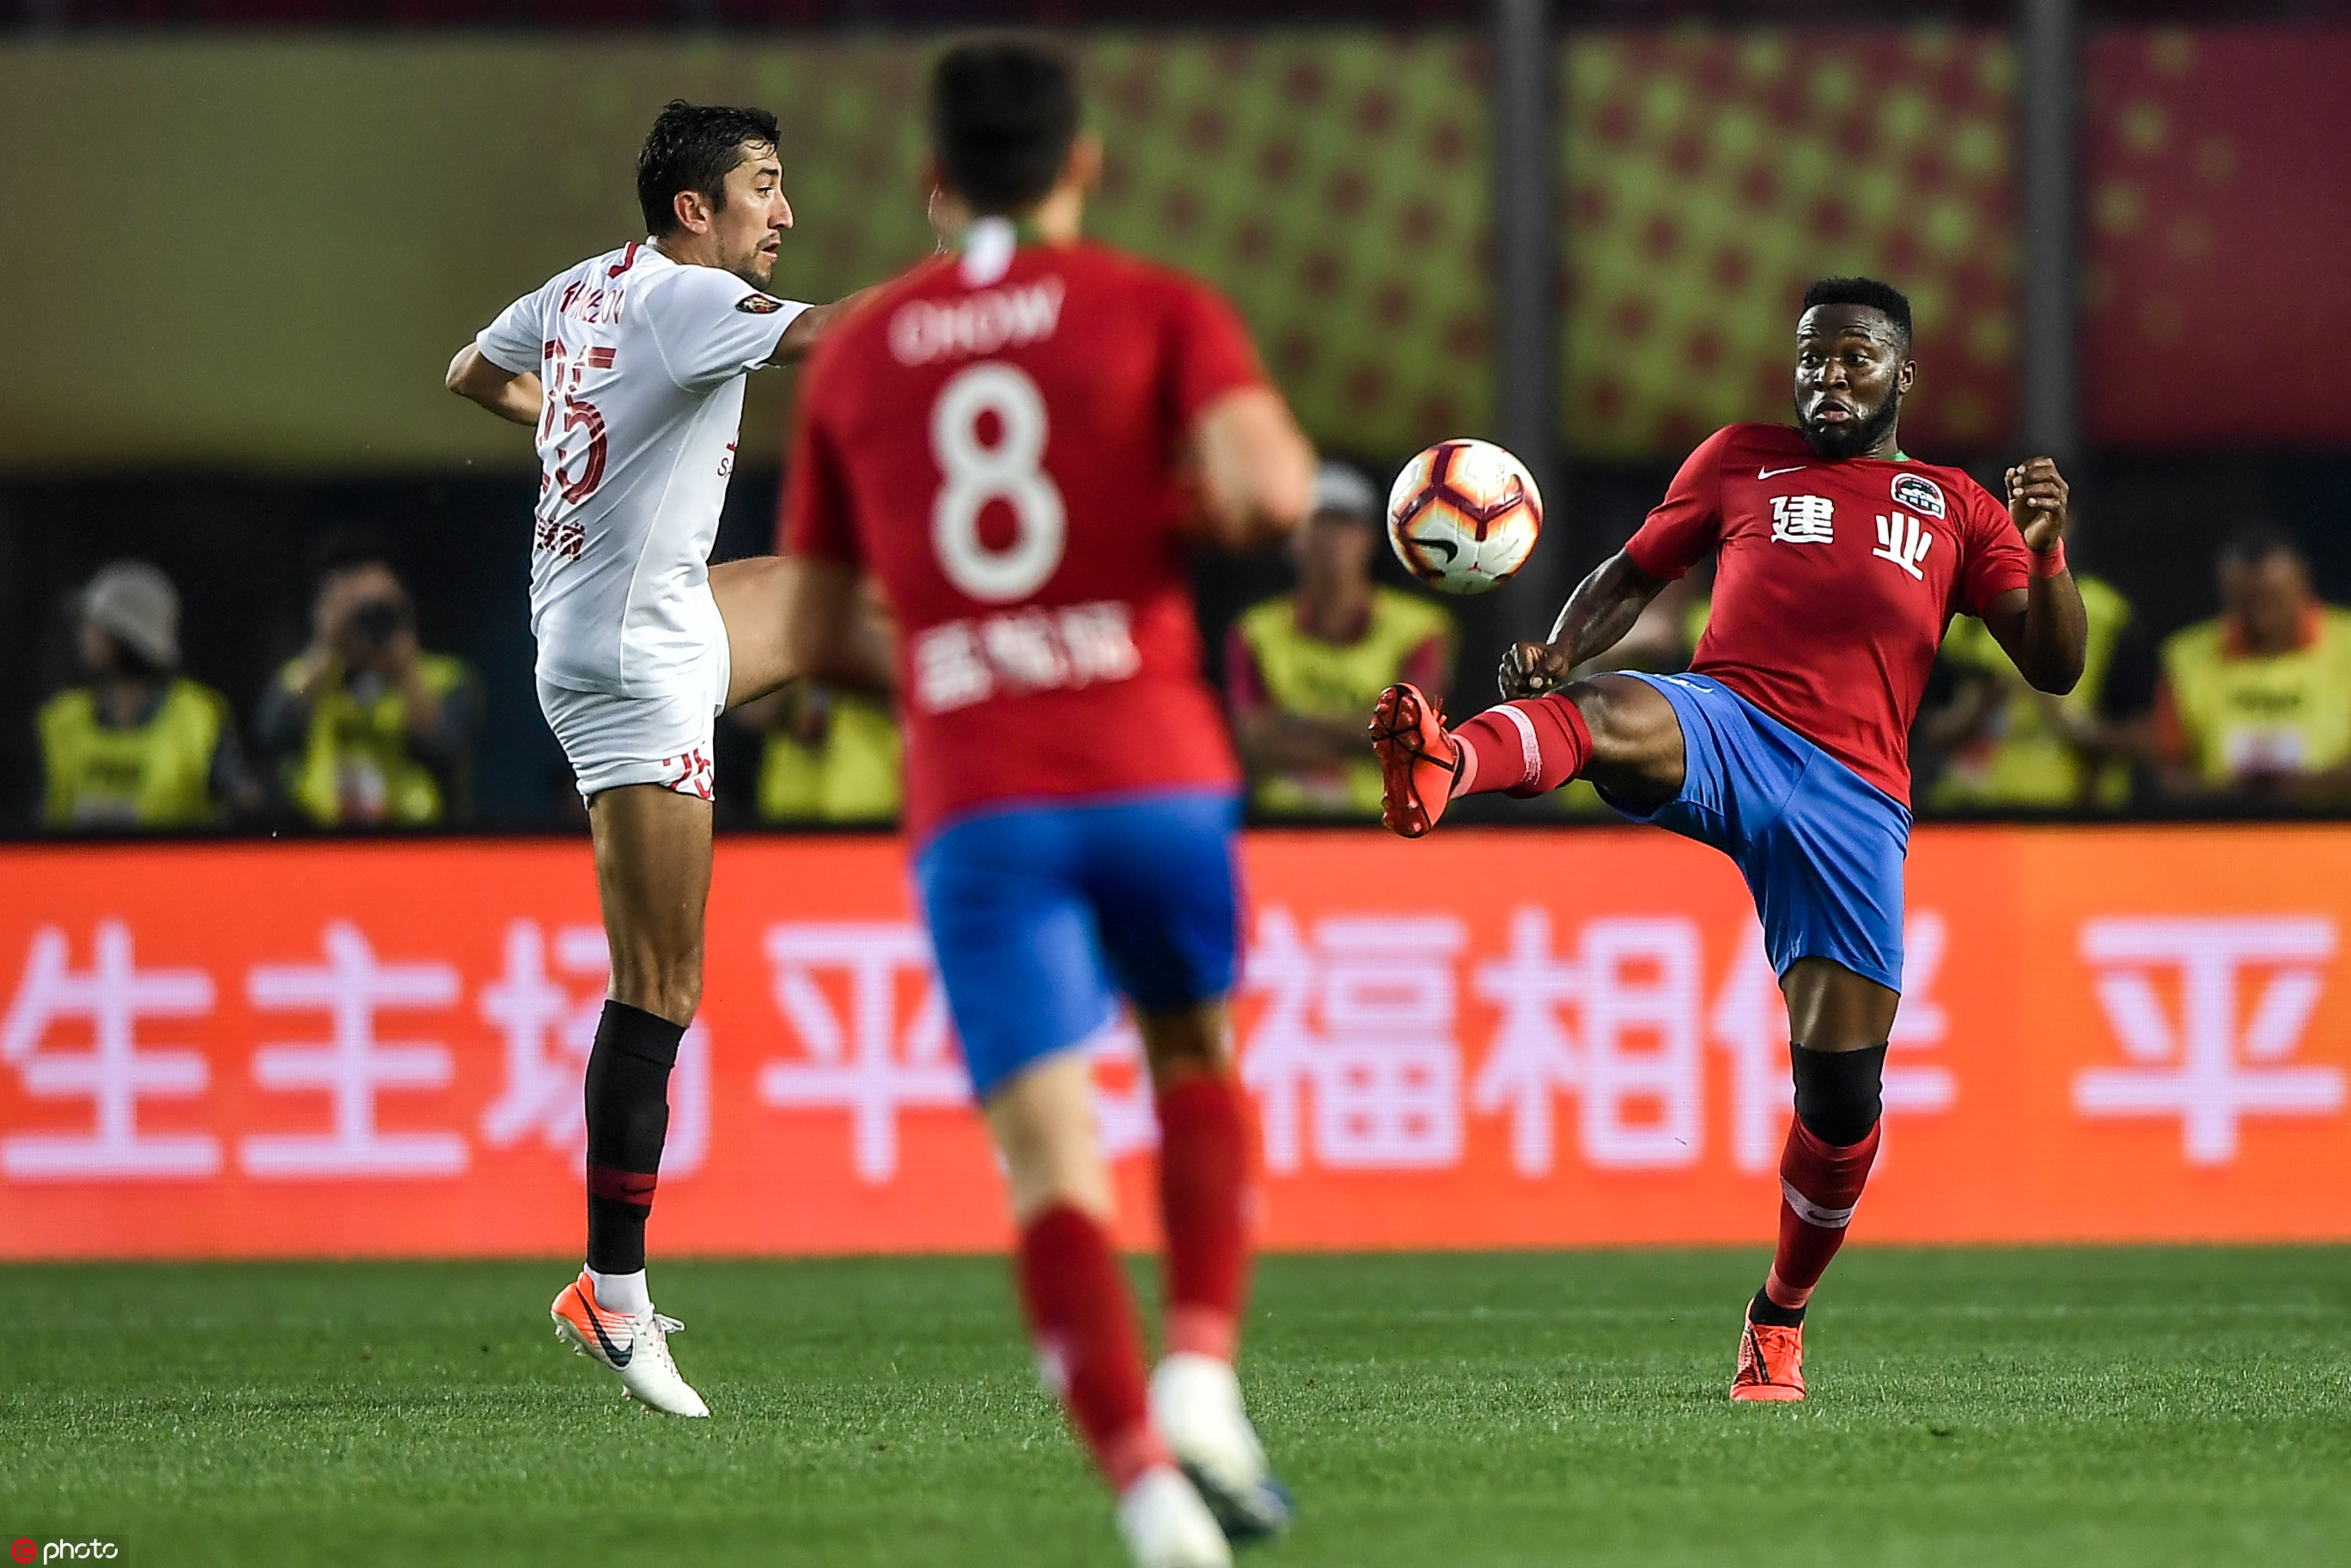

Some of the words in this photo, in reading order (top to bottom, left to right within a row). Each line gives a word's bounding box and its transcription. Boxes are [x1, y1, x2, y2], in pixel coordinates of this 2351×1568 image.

[931, 362, 1068, 601] 8
[1770, 495, 1933, 581] 建业
[2071, 915, 2347, 1166] 平
